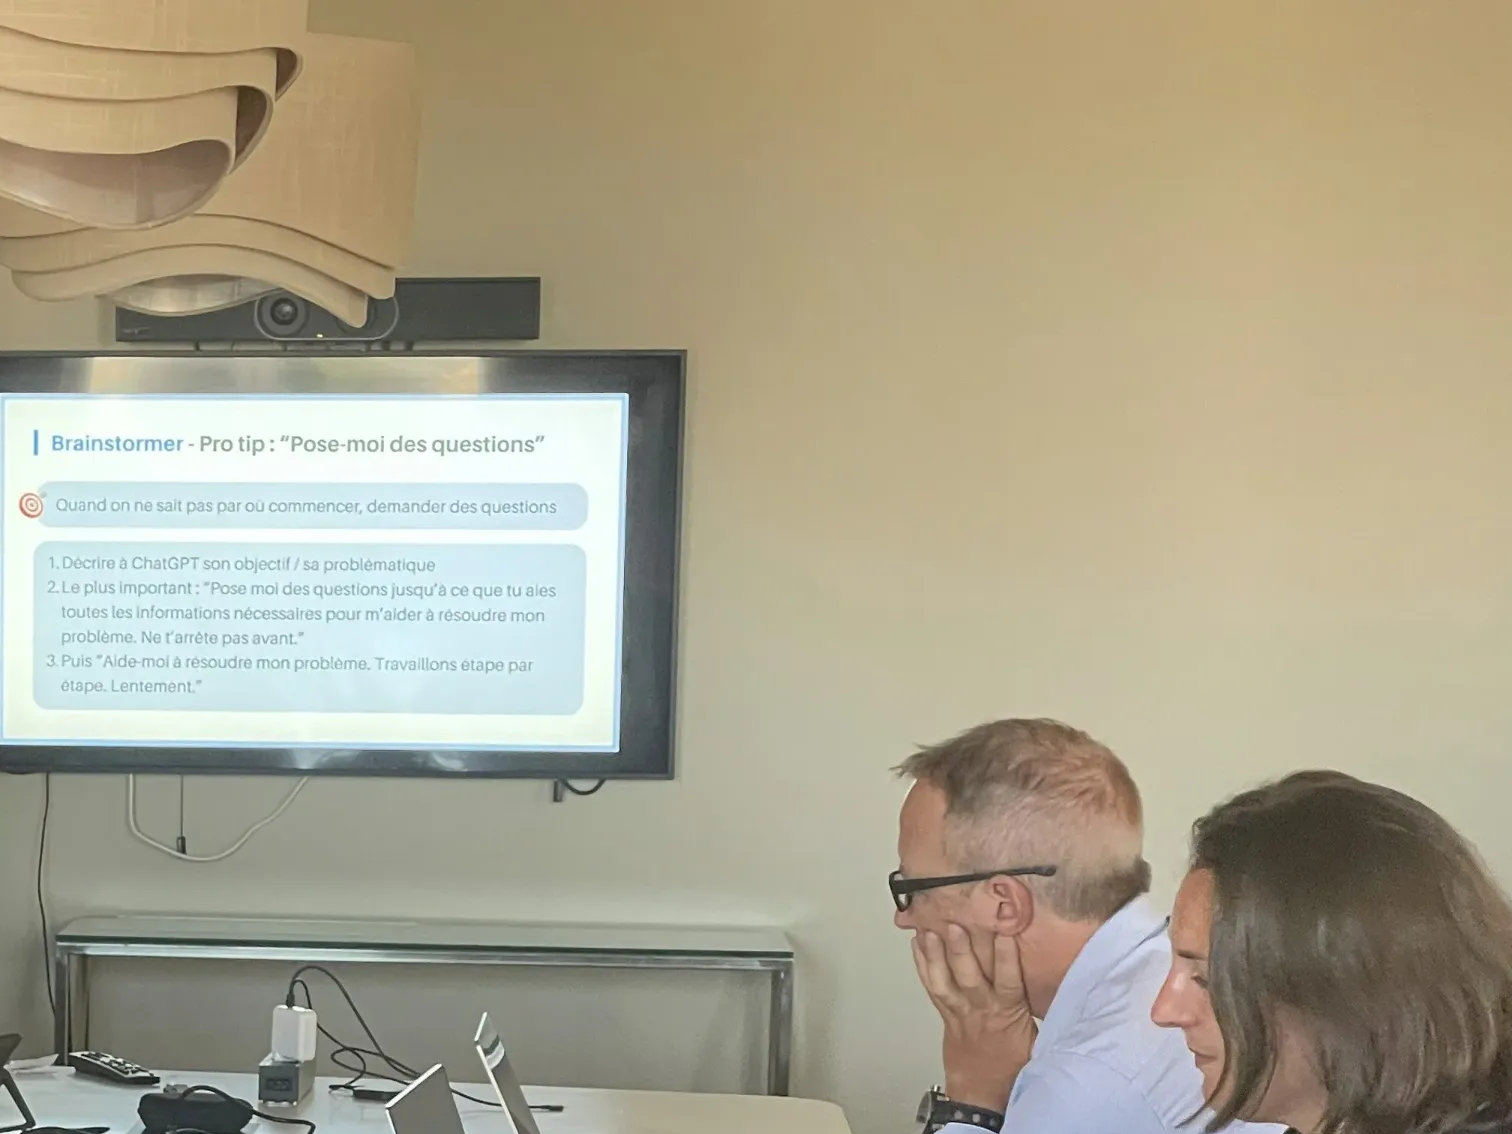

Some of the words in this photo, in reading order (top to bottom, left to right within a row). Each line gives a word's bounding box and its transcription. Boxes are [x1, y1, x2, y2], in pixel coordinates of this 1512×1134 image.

[52, 435, 184, 452] Brainstormer
[200, 436, 233, 452] Pro
[390, 435, 427, 452] des
[56, 498, 106, 512] Quand
[111, 501, 130, 512] on
[134, 501, 153, 512] ne
[156, 499, 182, 512] sait
[186, 501, 213, 516] pas
[217, 501, 242, 516] par
[268, 502, 363, 515] commencer,
[366, 499, 446, 514] demander
[449, 499, 478, 514] des
[480, 500, 557, 517] questions
[132, 556, 199, 570] ChatGPT
[204, 560, 230, 571] son
[234, 556, 291, 576] objectif
[303, 560, 319, 571] sa
[62, 581, 80, 594] Le
[84, 580, 116, 597] plus
[250, 582, 278, 596] moi
[282, 582, 310, 596] des
[313, 581, 388, 599] questions
[450, 586, 469, 597] ce
[473, 586, 503, 600] que
[507, 585, 522, 598] tu
[525, 584, 556, 597] aies
[62, 606, 108, 619] toutes
[112, 605, 132, 619] les
[136, 605, 230, 620] informations
[326, 610, 362, 623] pour
[511, 612, 544, 622] mon
[141, 631, 161, 644] Ne
[222, 634, 249, 647] pas
[62, 654, 92, 668] Puis
[256, 658, 290, 669] mon
[374, 657, 457, 671] Travaillons
[508, 661, 534, 675] par
